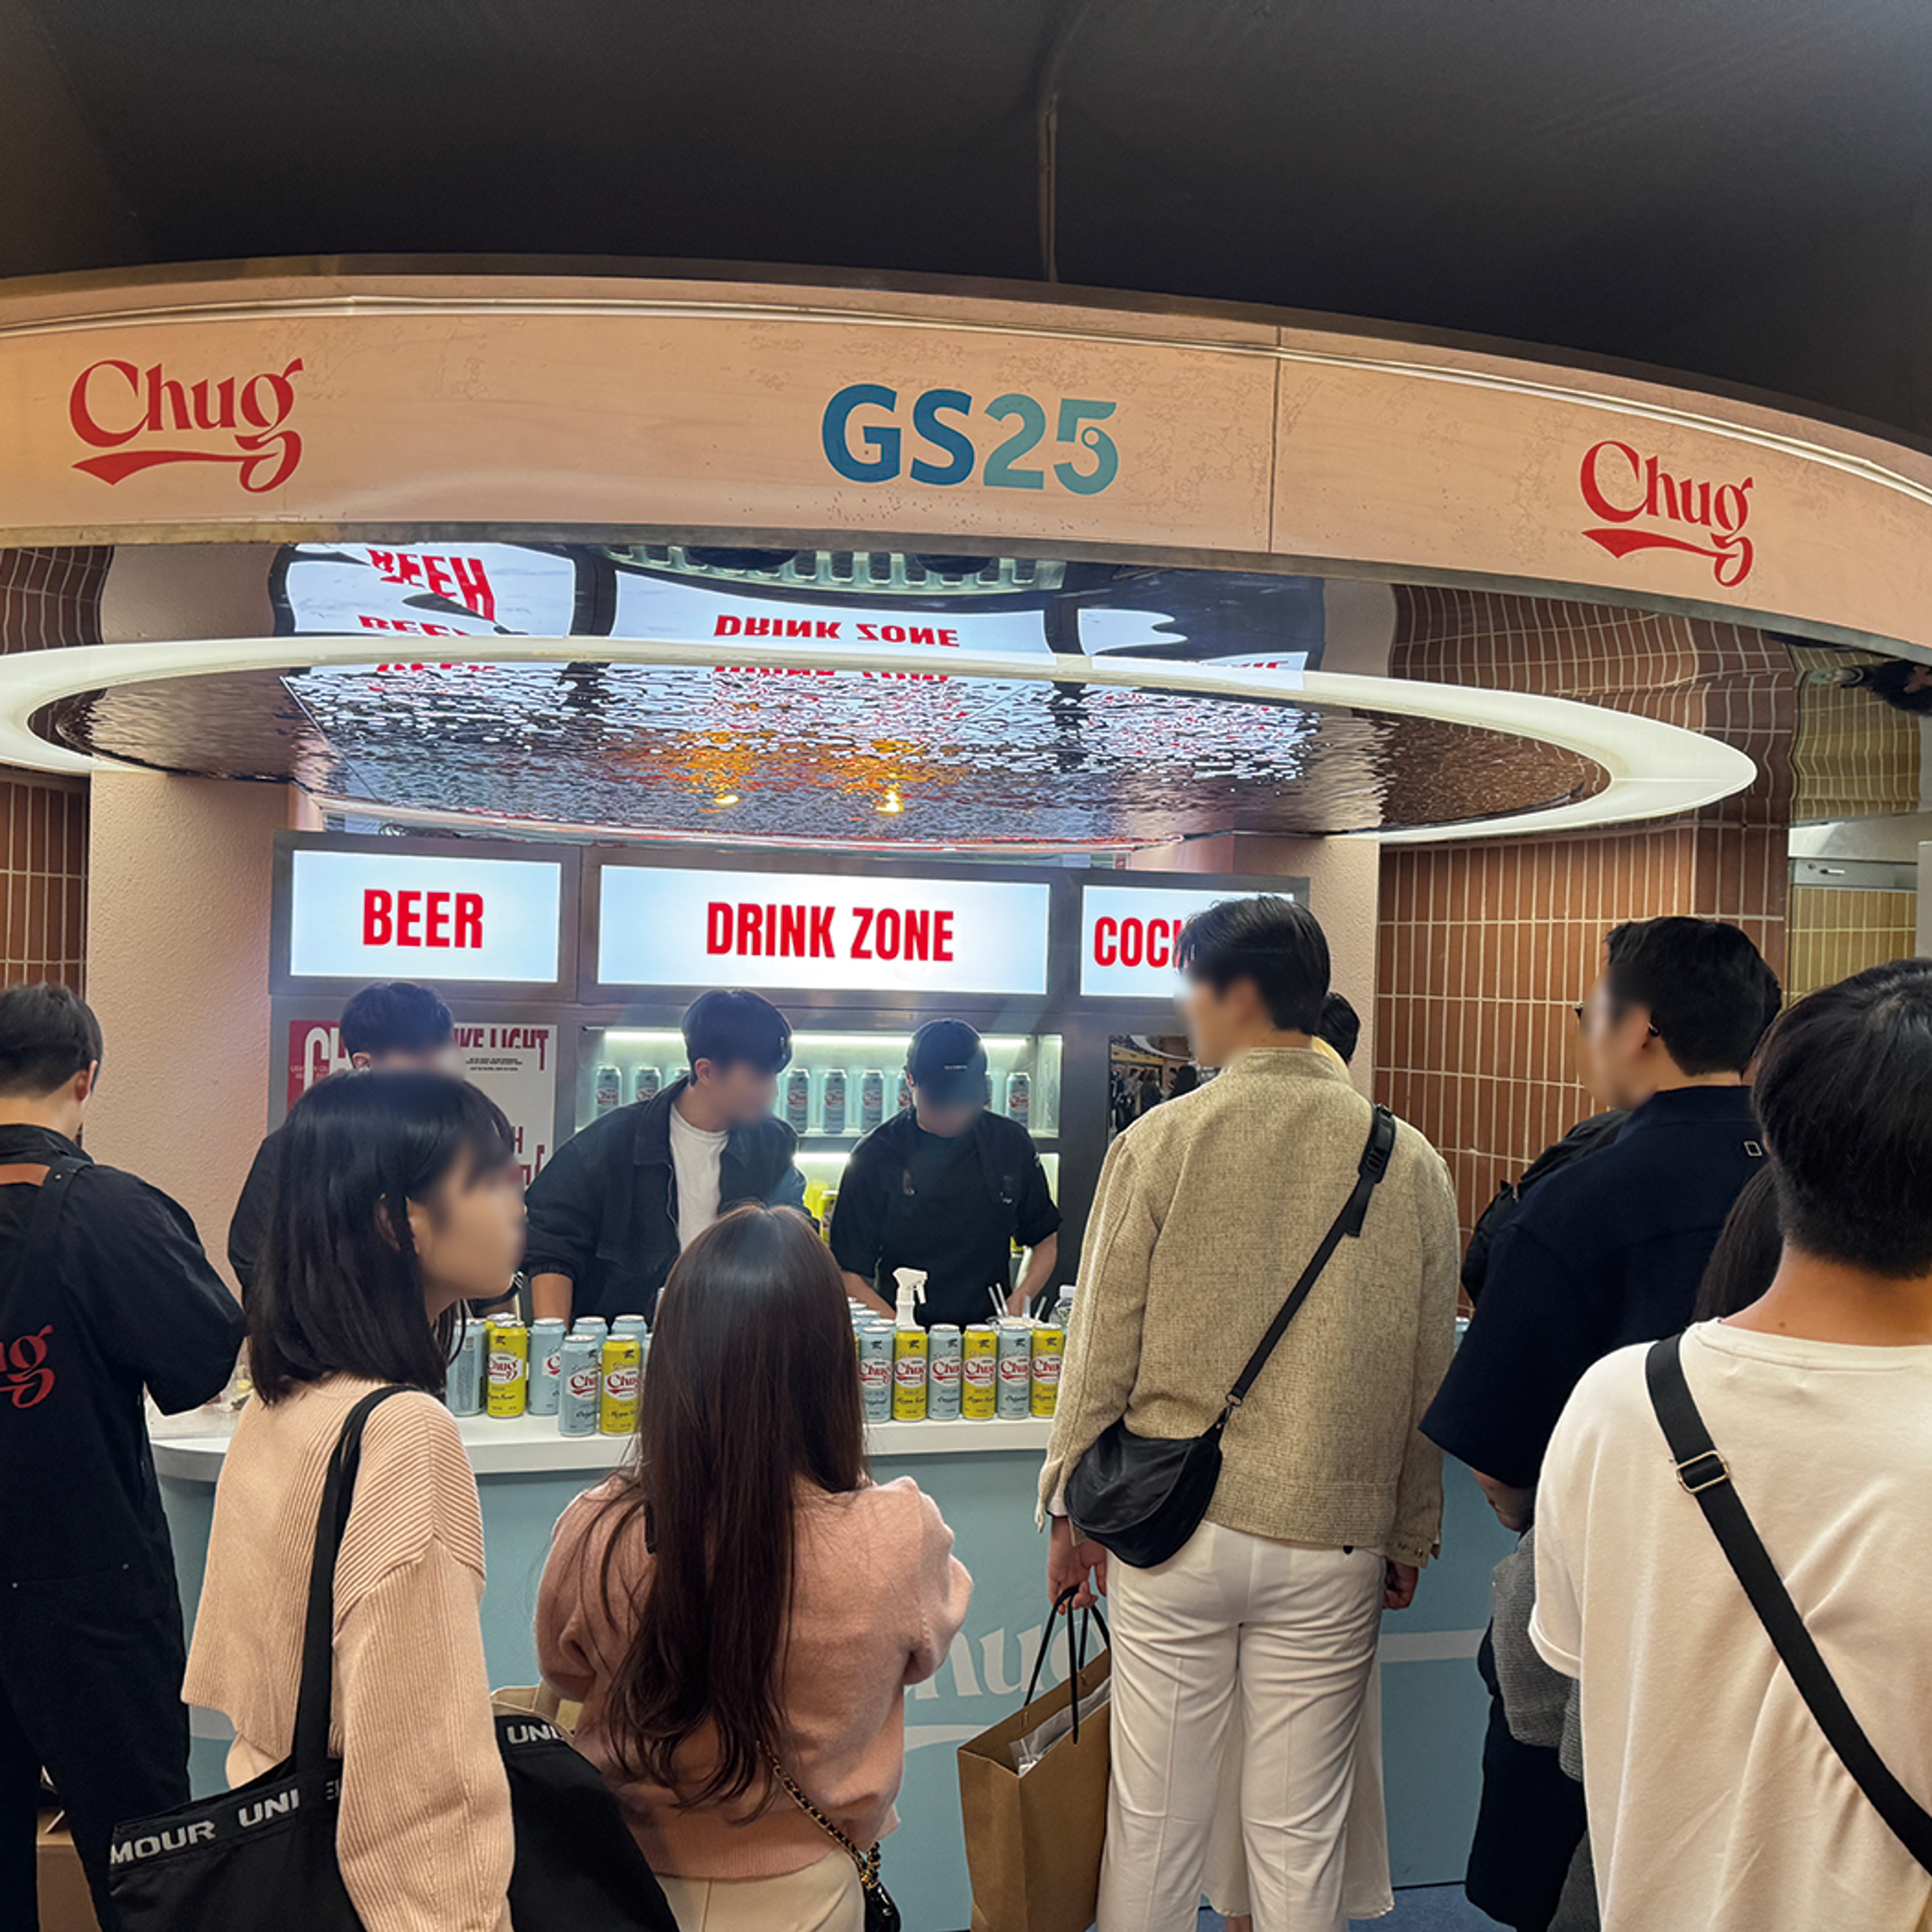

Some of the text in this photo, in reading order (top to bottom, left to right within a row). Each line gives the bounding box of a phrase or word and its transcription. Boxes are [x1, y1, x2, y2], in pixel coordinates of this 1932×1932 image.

[69, 358, 304, 493] Chug
[822, 383, 1118, 495] GS25
[1580, 441, 1753, 587] Chug
[363, 889, 484, 948] BEER
[706, 902, 954, 961] DRINK ZONE
